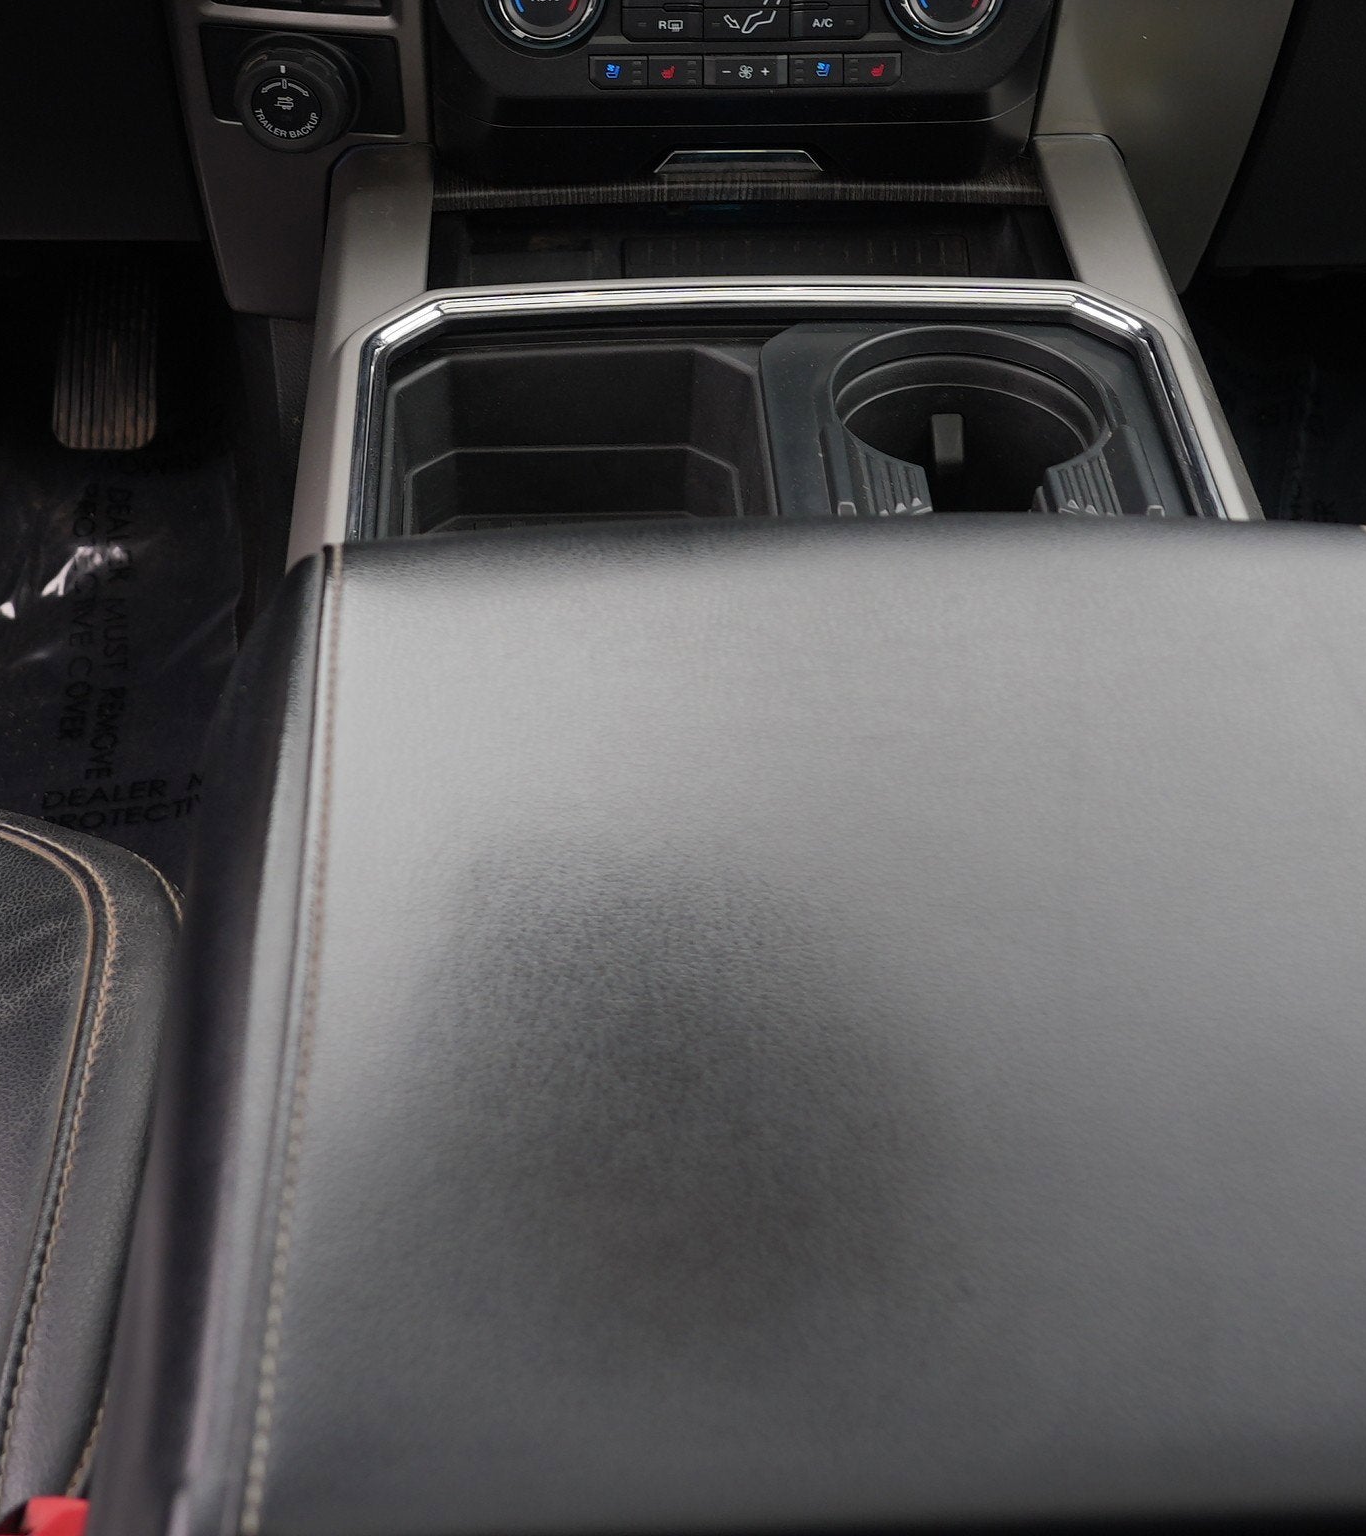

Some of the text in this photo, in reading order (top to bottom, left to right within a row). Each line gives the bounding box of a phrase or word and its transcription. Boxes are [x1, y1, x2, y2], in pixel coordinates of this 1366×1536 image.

[658, 20, 667, 31] R
[812, 17, 834, 29] A/C
[254, 107, 319, 139] TRAILER BACKUP
[42, 778, 167, 811] DEALER
